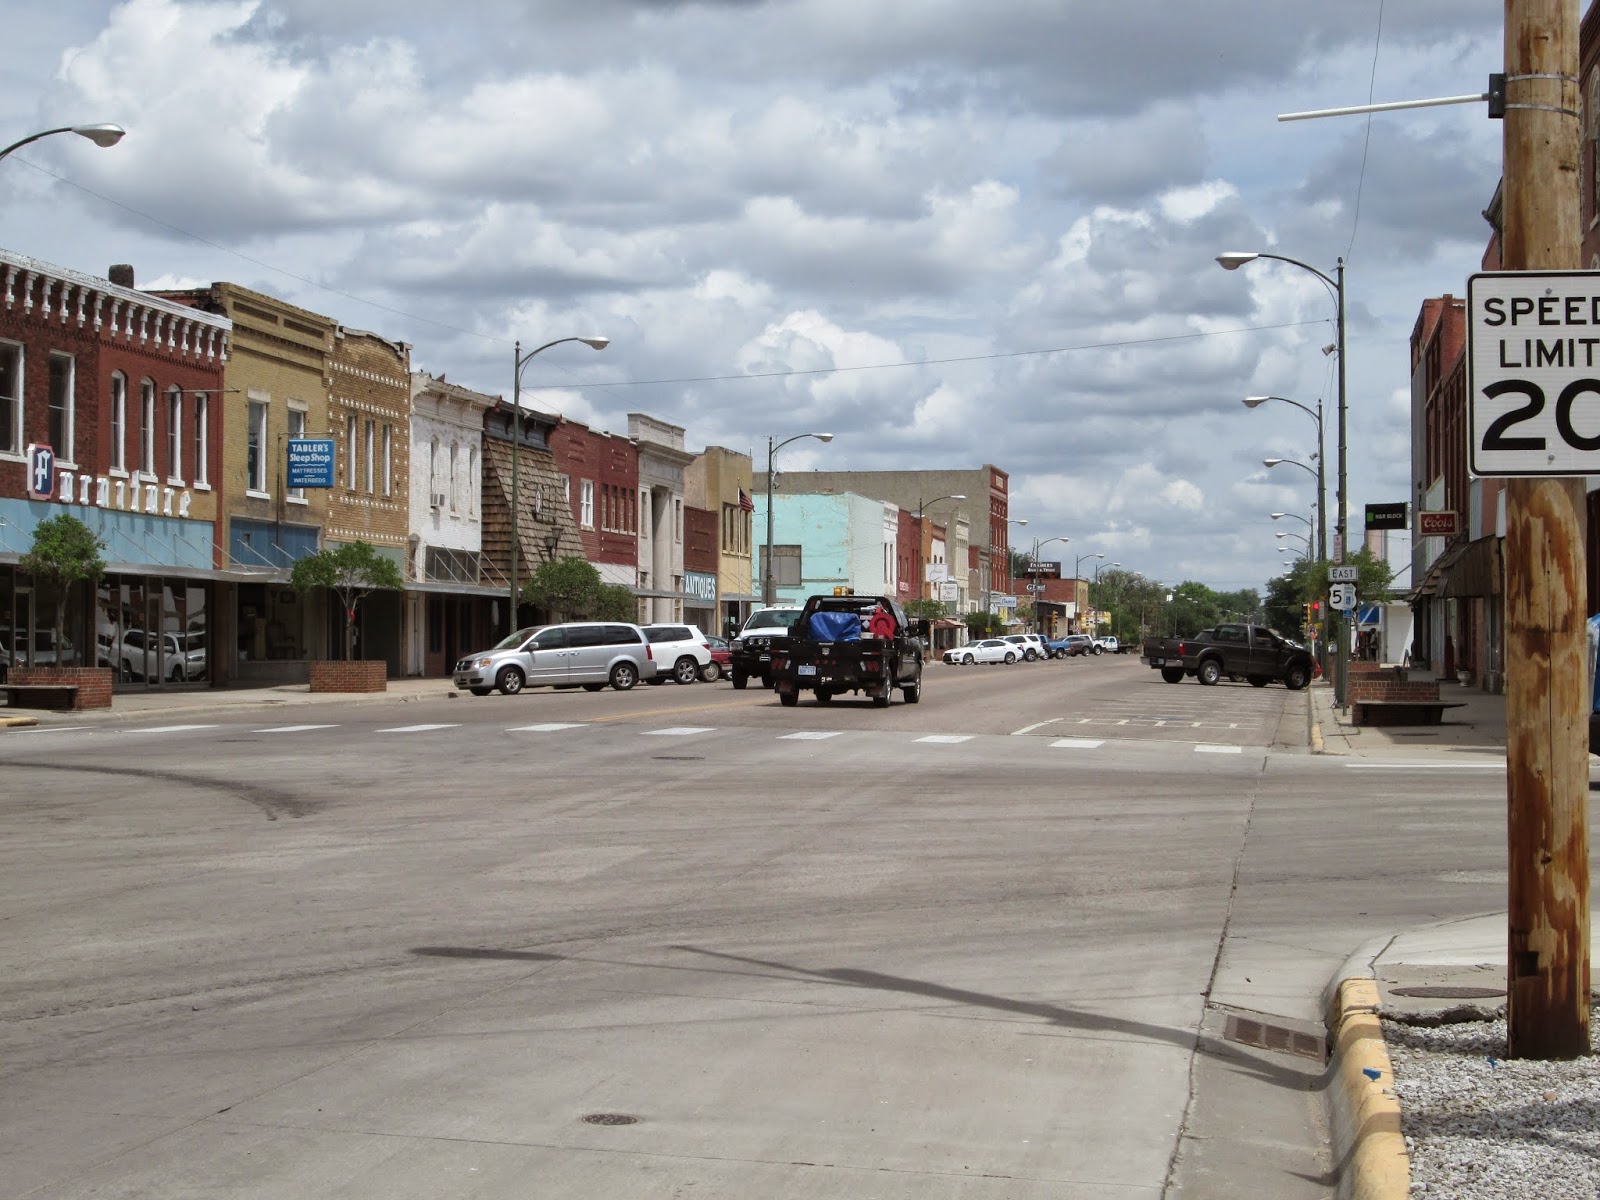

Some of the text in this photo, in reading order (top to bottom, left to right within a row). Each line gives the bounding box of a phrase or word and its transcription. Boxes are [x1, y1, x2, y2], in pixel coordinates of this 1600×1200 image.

[1500, 338, 1600, 368] LIMIT
[1481, 378, 1600, 451] 20
[291, 443, 329, 453] TABLER'S
[289, 453, 331, 463] Sleep Shop
[1423, 516, 1453, 528] Coors
[1332, 569, 1353, 579] EAST
[684, 574, 716, 600] ANTIQUES
